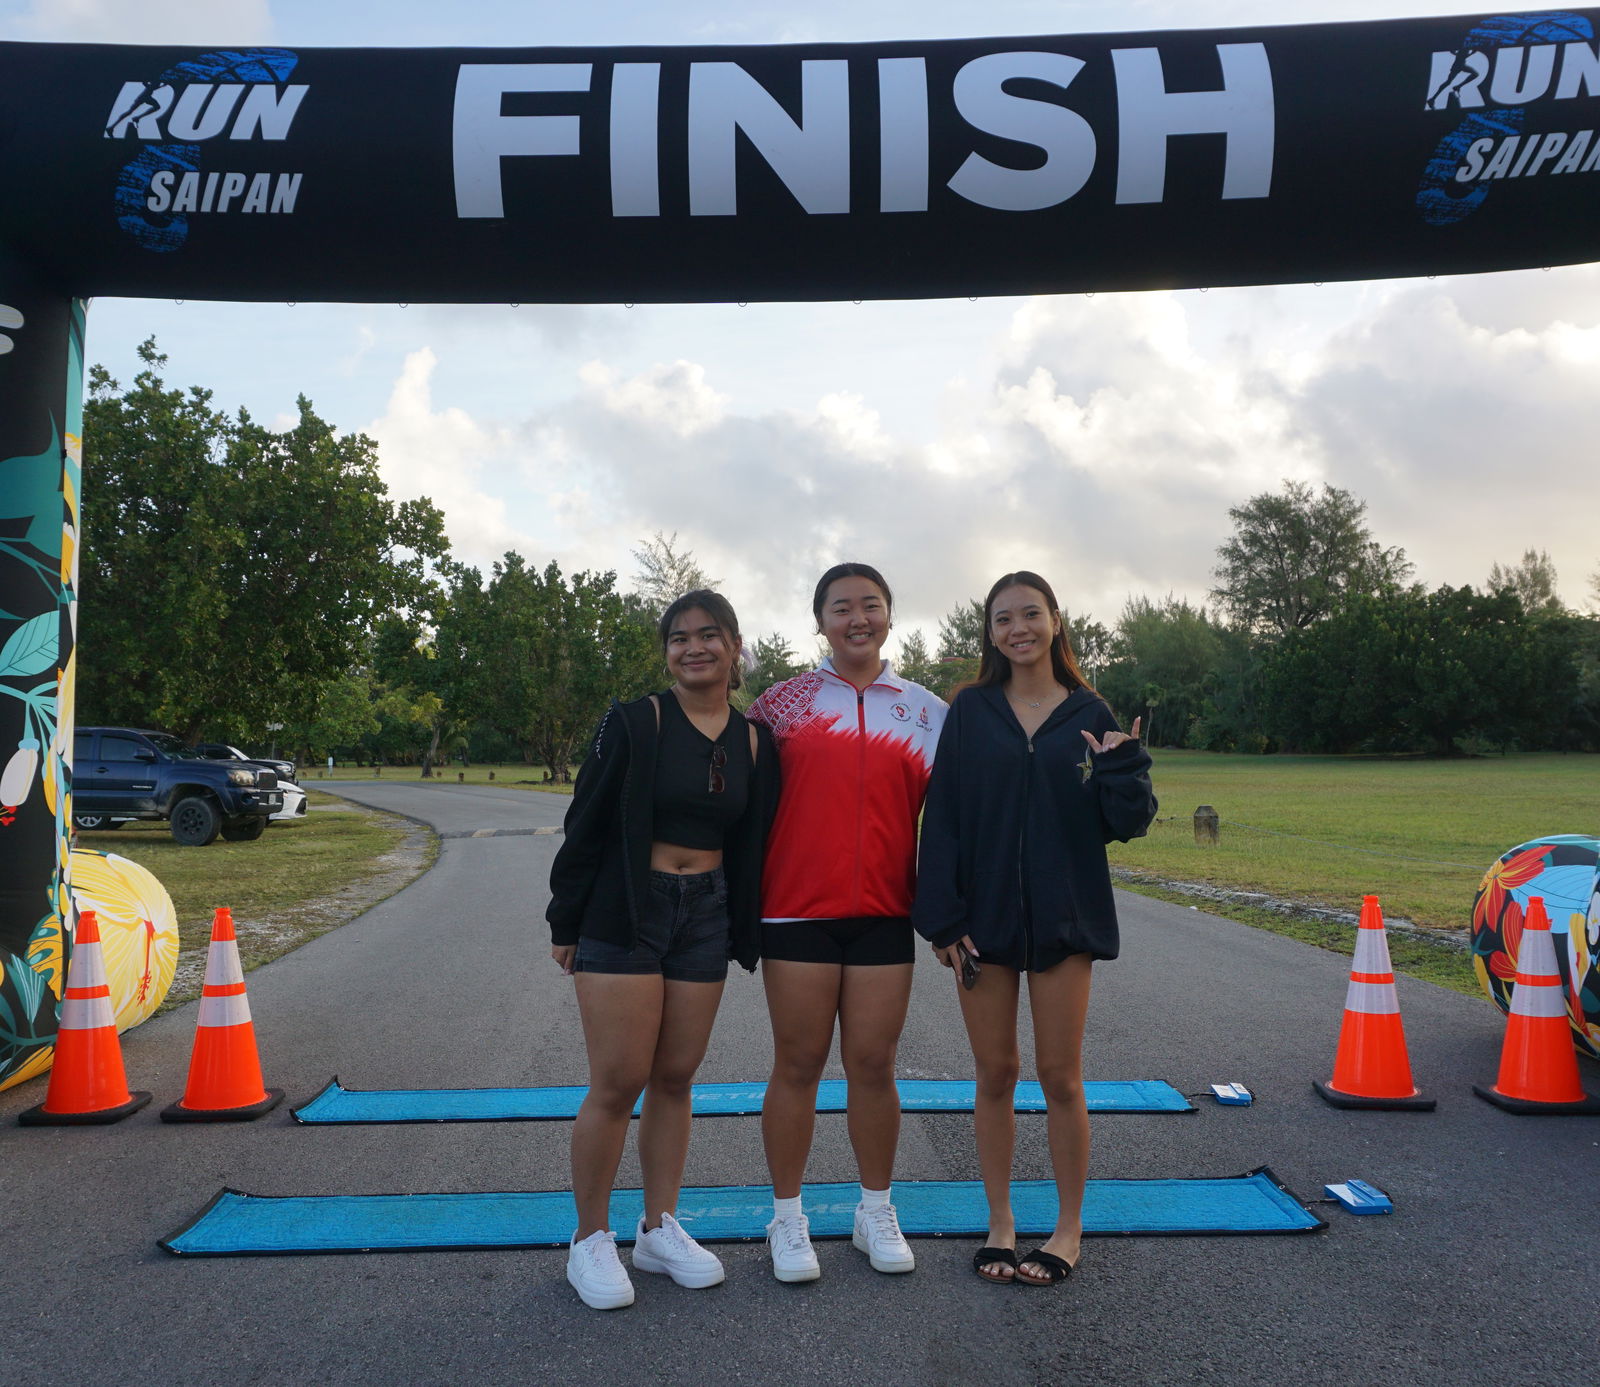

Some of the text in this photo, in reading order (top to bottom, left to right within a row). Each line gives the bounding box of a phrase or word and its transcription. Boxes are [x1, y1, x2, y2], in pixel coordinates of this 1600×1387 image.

[103, 81, 310, 140] RUN
[452, 41, 1276, 219] FINISH
[147, 170, 303, 214] SAIPAN
